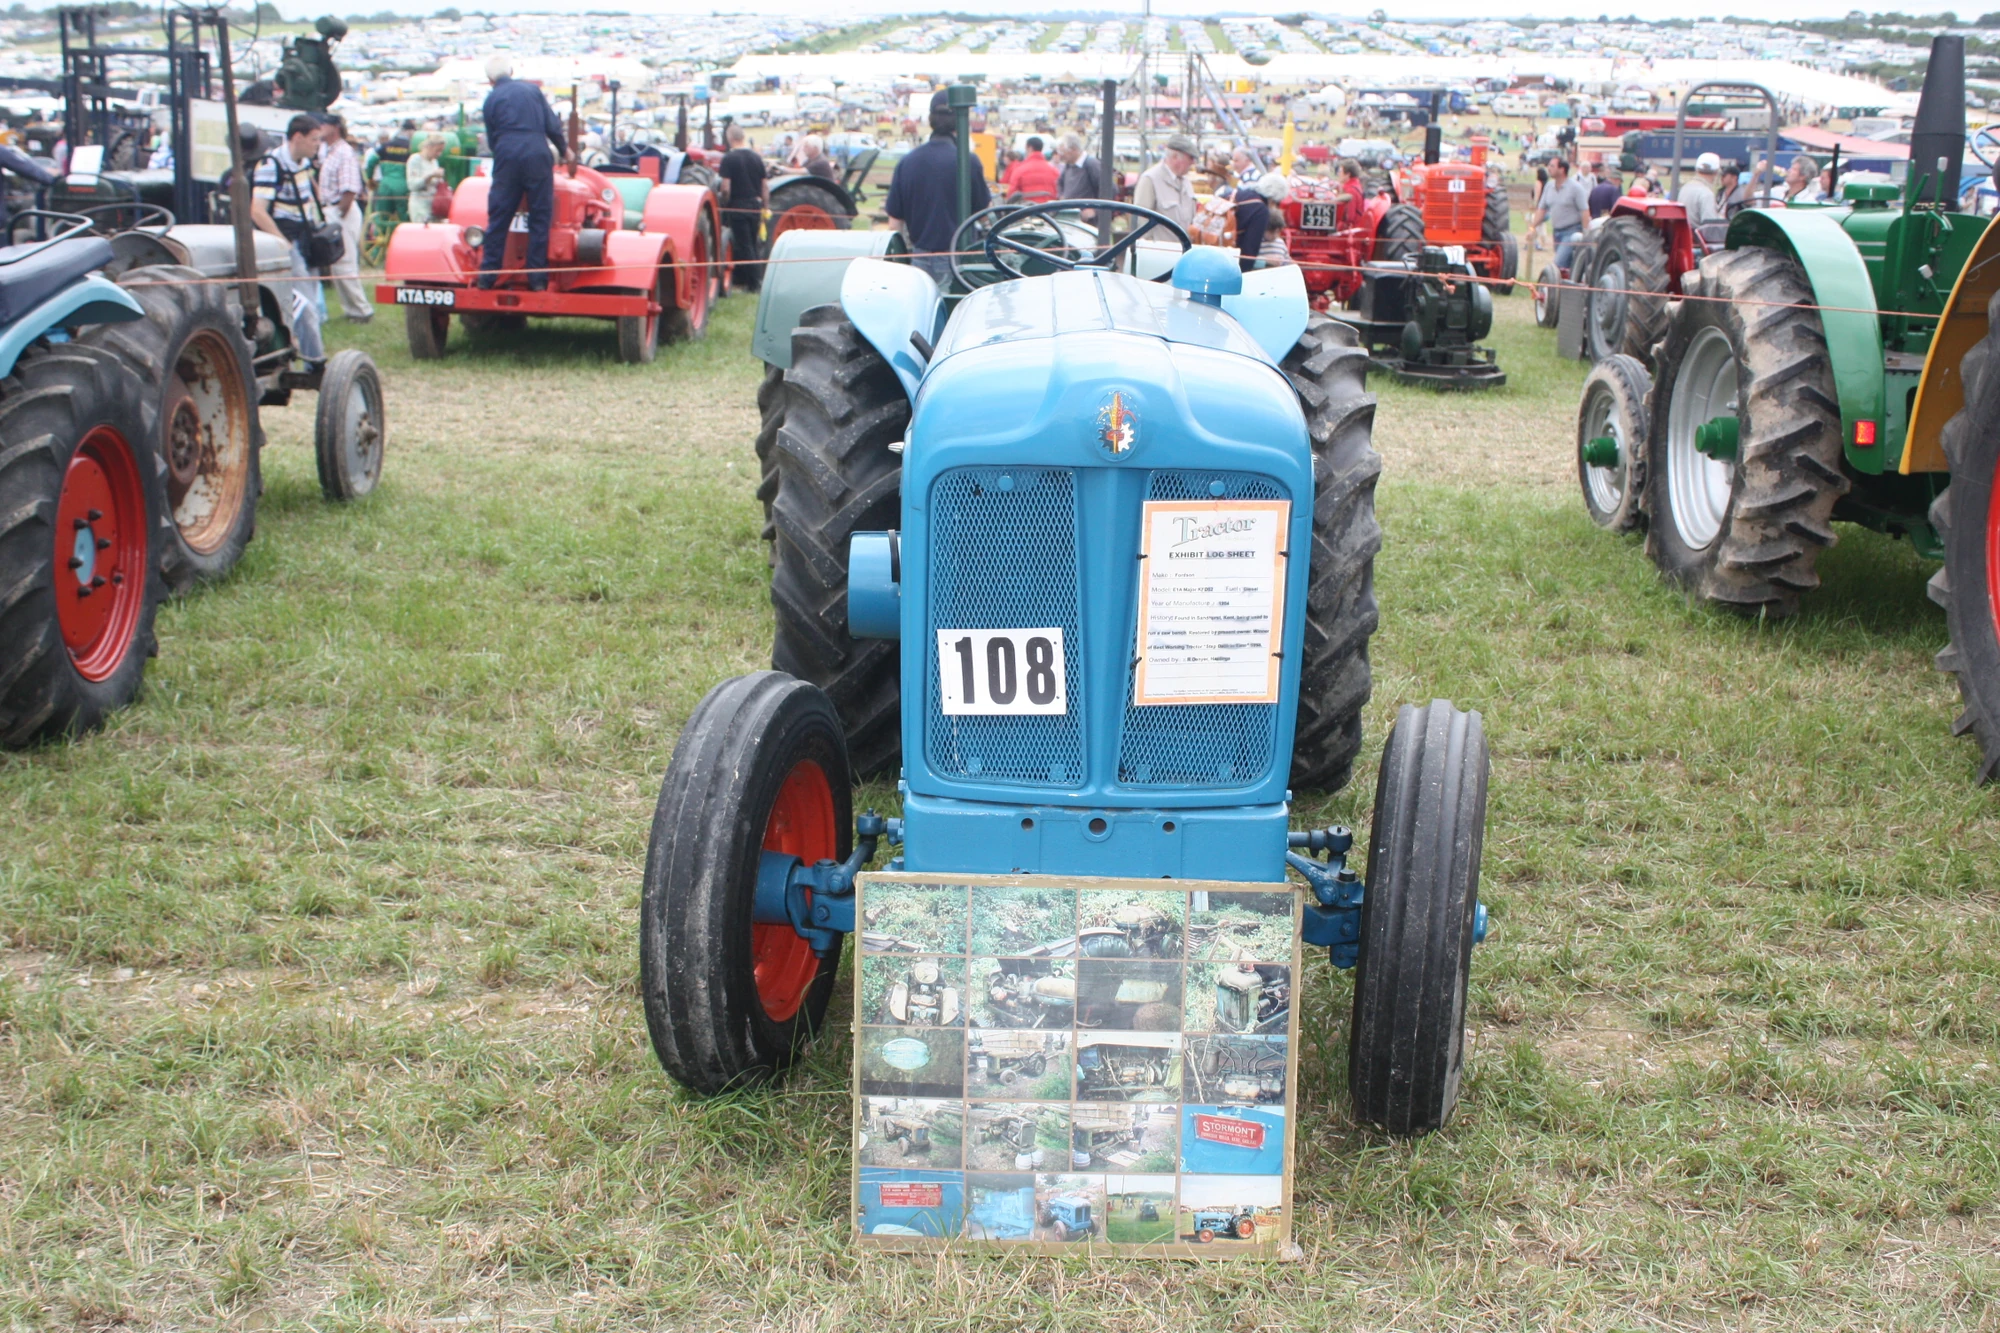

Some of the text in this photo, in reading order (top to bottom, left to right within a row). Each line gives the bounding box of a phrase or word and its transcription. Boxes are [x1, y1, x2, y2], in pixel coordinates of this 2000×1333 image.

[1307, 206, 1331, 217] VTK
[1306, 216, 1331, 226] 379
[397, 288, 454, 305] KTA598
[1171, 516, 1256, 548] Tractor
[1169, 550, 1256, 559] EXHIBIT LOG SHEET
[955, 636, 1056, 705] 108
[1202, 1121, 1256, 1139] STORMONT
